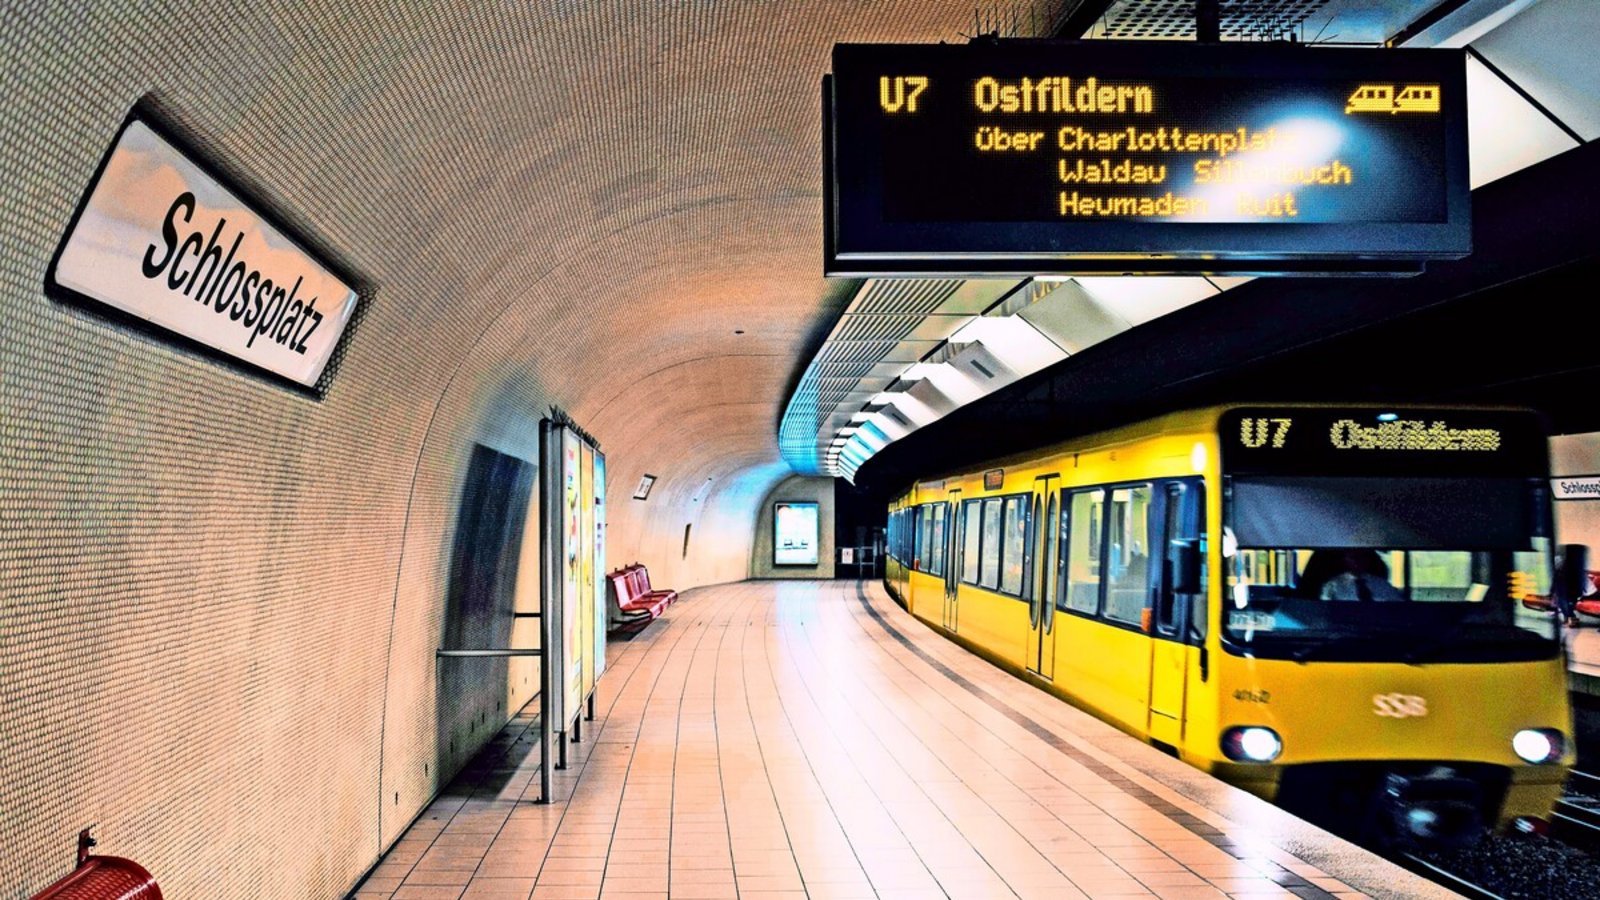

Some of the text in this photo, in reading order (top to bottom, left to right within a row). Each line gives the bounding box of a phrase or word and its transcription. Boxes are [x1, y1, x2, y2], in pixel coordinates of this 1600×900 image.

[879, 76, 1154, 113] U7 Ostfildern
[1057, 126, 1296, 157] Charlottenplat
[1058, 158, 1353, 185] Waldau Sillbuch
[1059, 191, 1208, 217] Heumaden
[142, 191, 324, 355] Schlossplatz
[1240, 418, 1293, 449] U7
